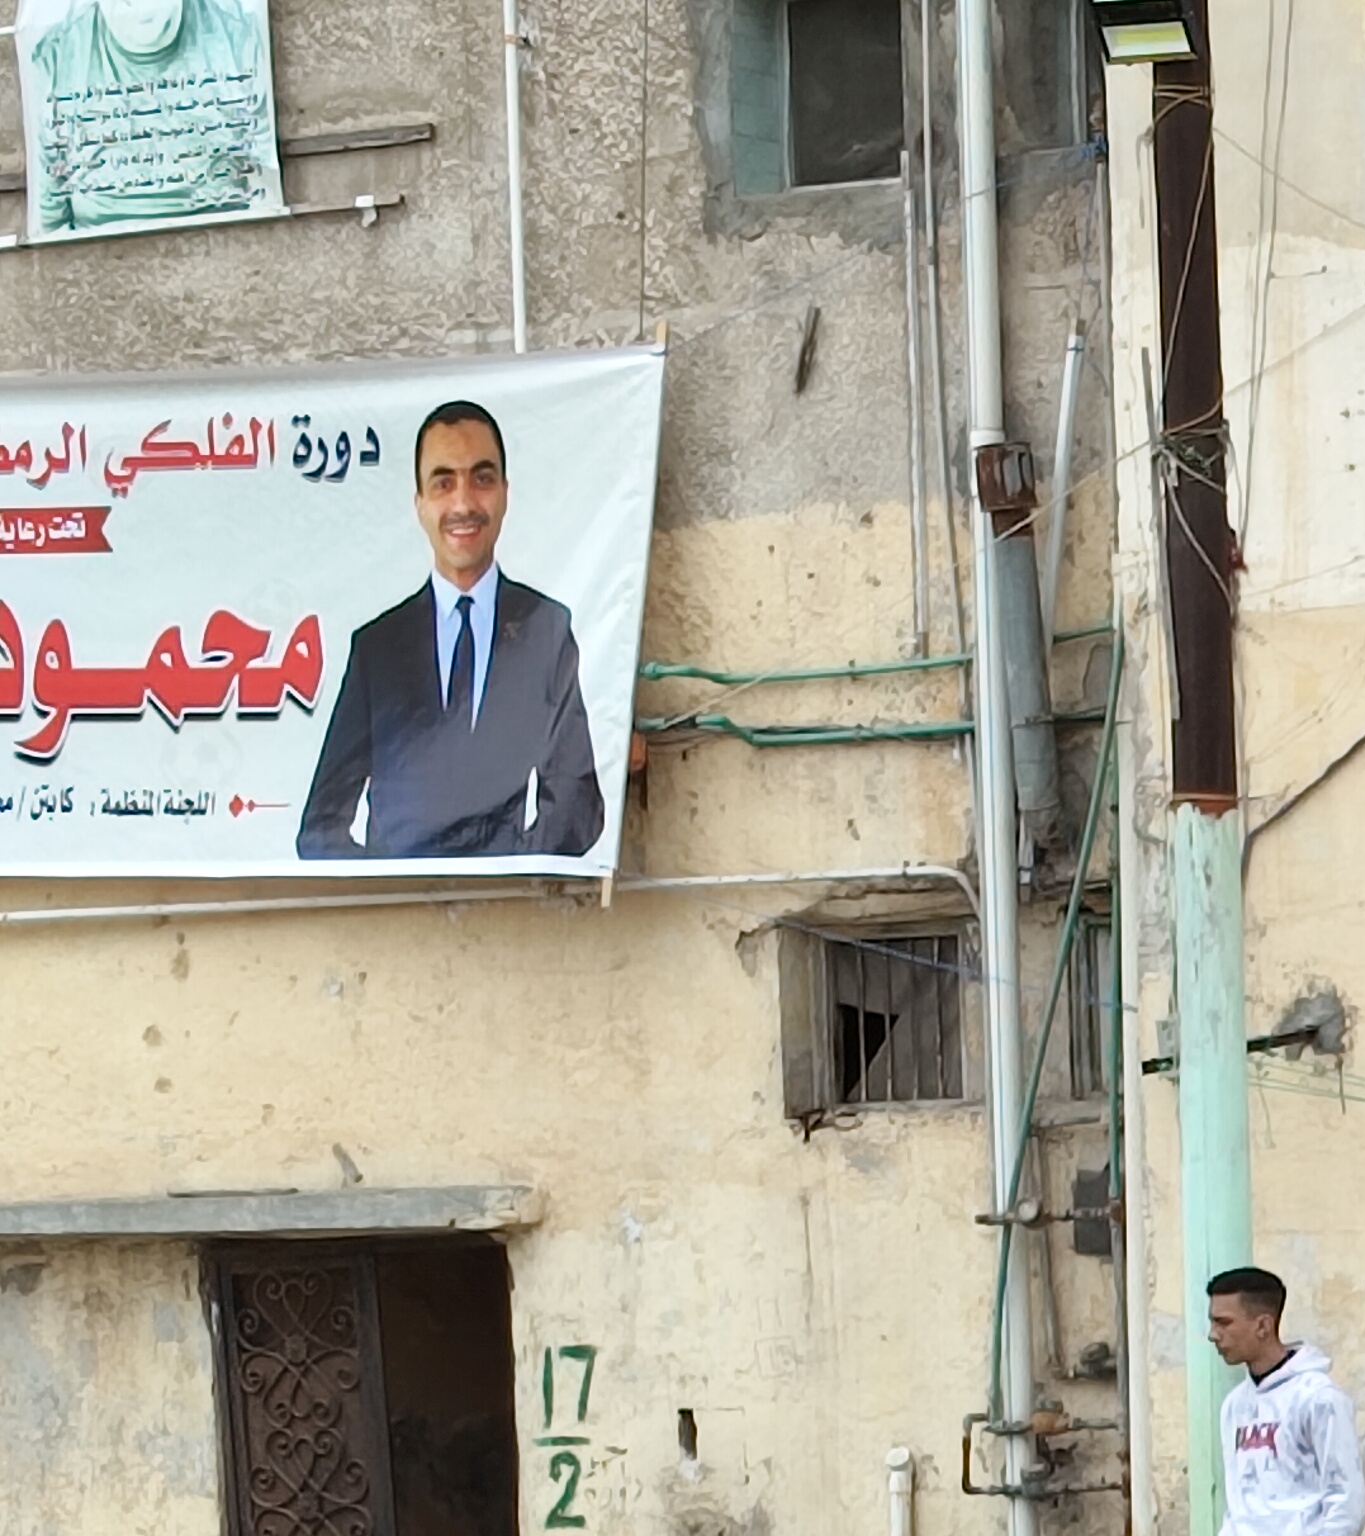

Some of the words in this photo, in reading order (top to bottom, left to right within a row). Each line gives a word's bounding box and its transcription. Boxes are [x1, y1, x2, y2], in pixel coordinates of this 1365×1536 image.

[103, 411, 275, 498] الفلكي
[291, 413, 380, 483] دورة
[48, 512, 86, 540] تحت
[162, 788, 216, 825] اللجنة
[543, 1344, 598, 1429] 17
[544, 1450, 586, 1528] 2
